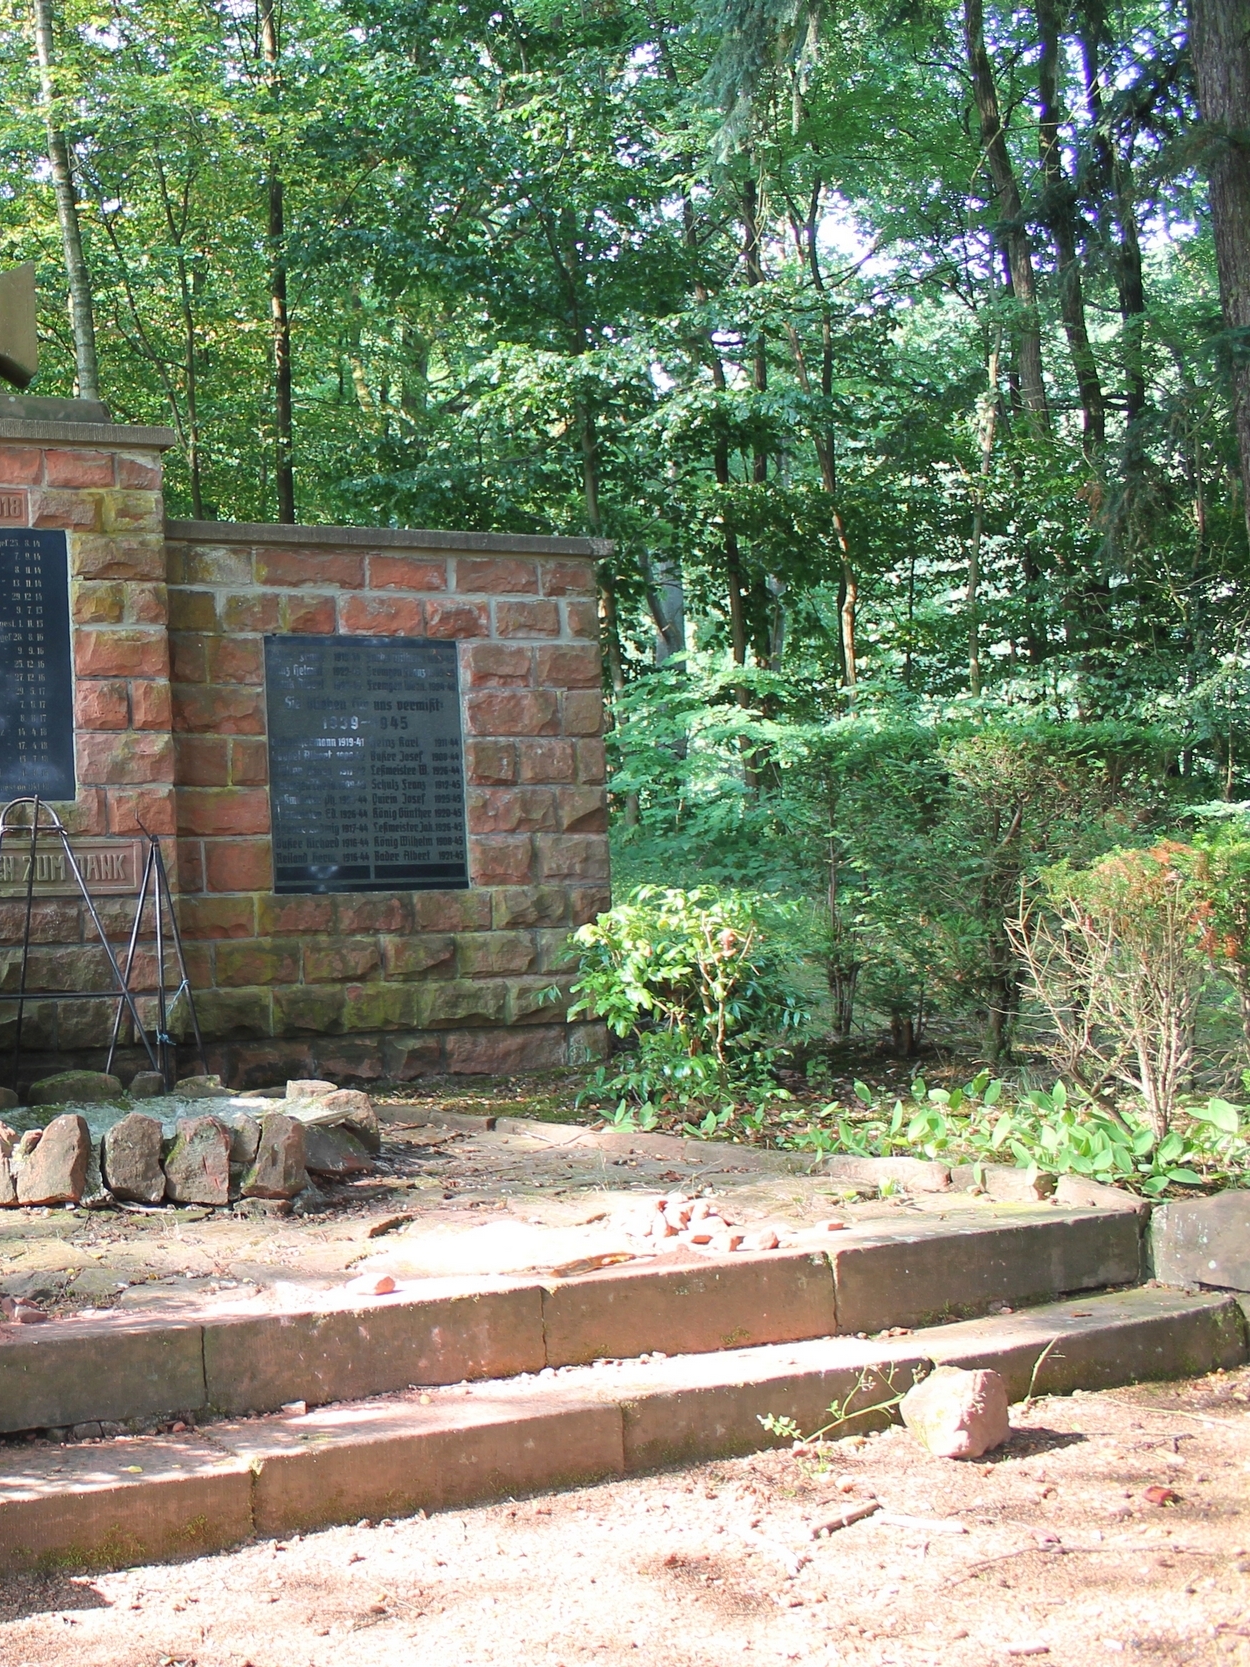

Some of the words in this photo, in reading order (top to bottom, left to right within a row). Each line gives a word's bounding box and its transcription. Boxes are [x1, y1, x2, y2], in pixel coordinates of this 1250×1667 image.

[373, 700, 392, 712] uns
[338, 736, 366, 748] 1919-41
[399, 750, 424, 763] Josef
[401, 779, 427, 792] Franz
[401, 793, 426, 806] Josef
[372, 807, 398, 821] König
[373, 836, 399, 850] König
[399, 836, 434, 848] Wilhelm
[373, 850, 400, 862] Bader
[402, 849, 431, 862] Albert
